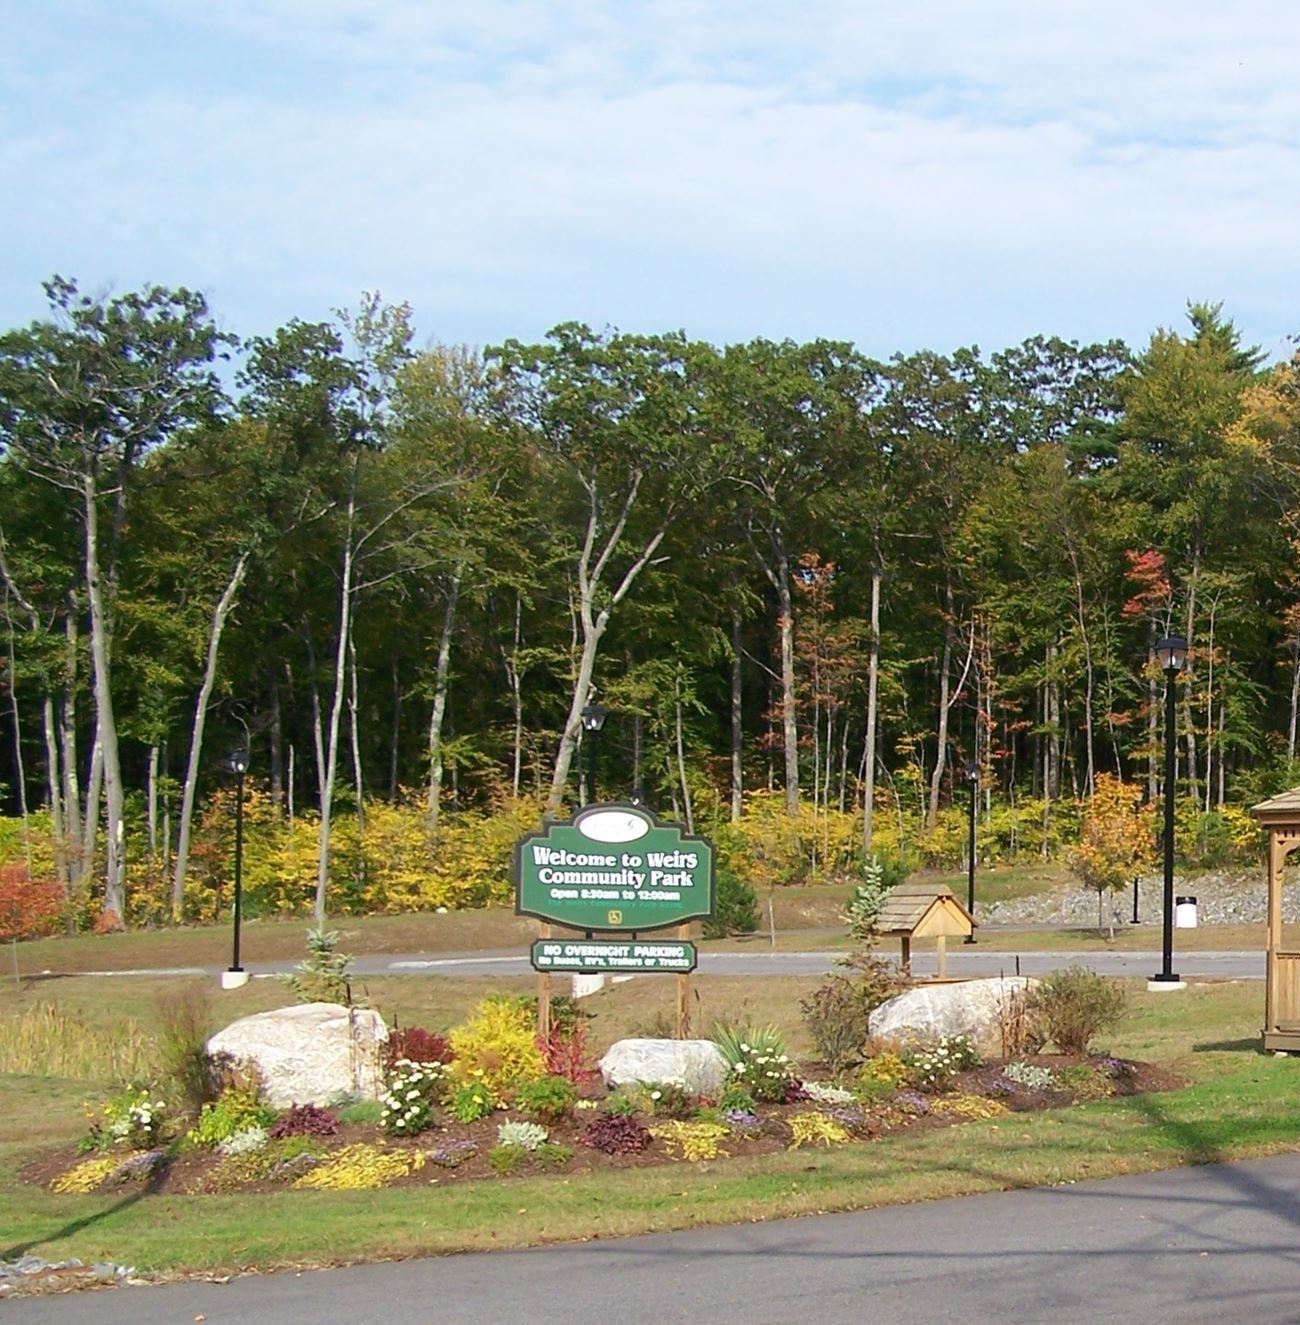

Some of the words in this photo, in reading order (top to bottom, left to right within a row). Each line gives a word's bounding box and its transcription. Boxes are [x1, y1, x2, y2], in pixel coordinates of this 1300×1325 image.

[533, 845, 617, 867] Welcome
[621, 854, 642, 867] to
[646, 850, 698, 869] Weirs
[538, 868, 646, 889] Community
[650, 870, 693, 886] Park
[550, 888, 579, 899] Open
[622, 890, 636, 900] to
[637, 890, 681, 900] 12:00am
[543, 945, 562, 956] NO
[564, 945, 630, 957] OVERNIGHT
[634, 946, 685, 958] PARKING
[538, 956, 552, 965] No
[553, 957, 583, 966] Buses,
[607, 957, 643, 966] Trailers
[644, 958, 656, 966] or
[658, 958, 690, 967] Trucks
